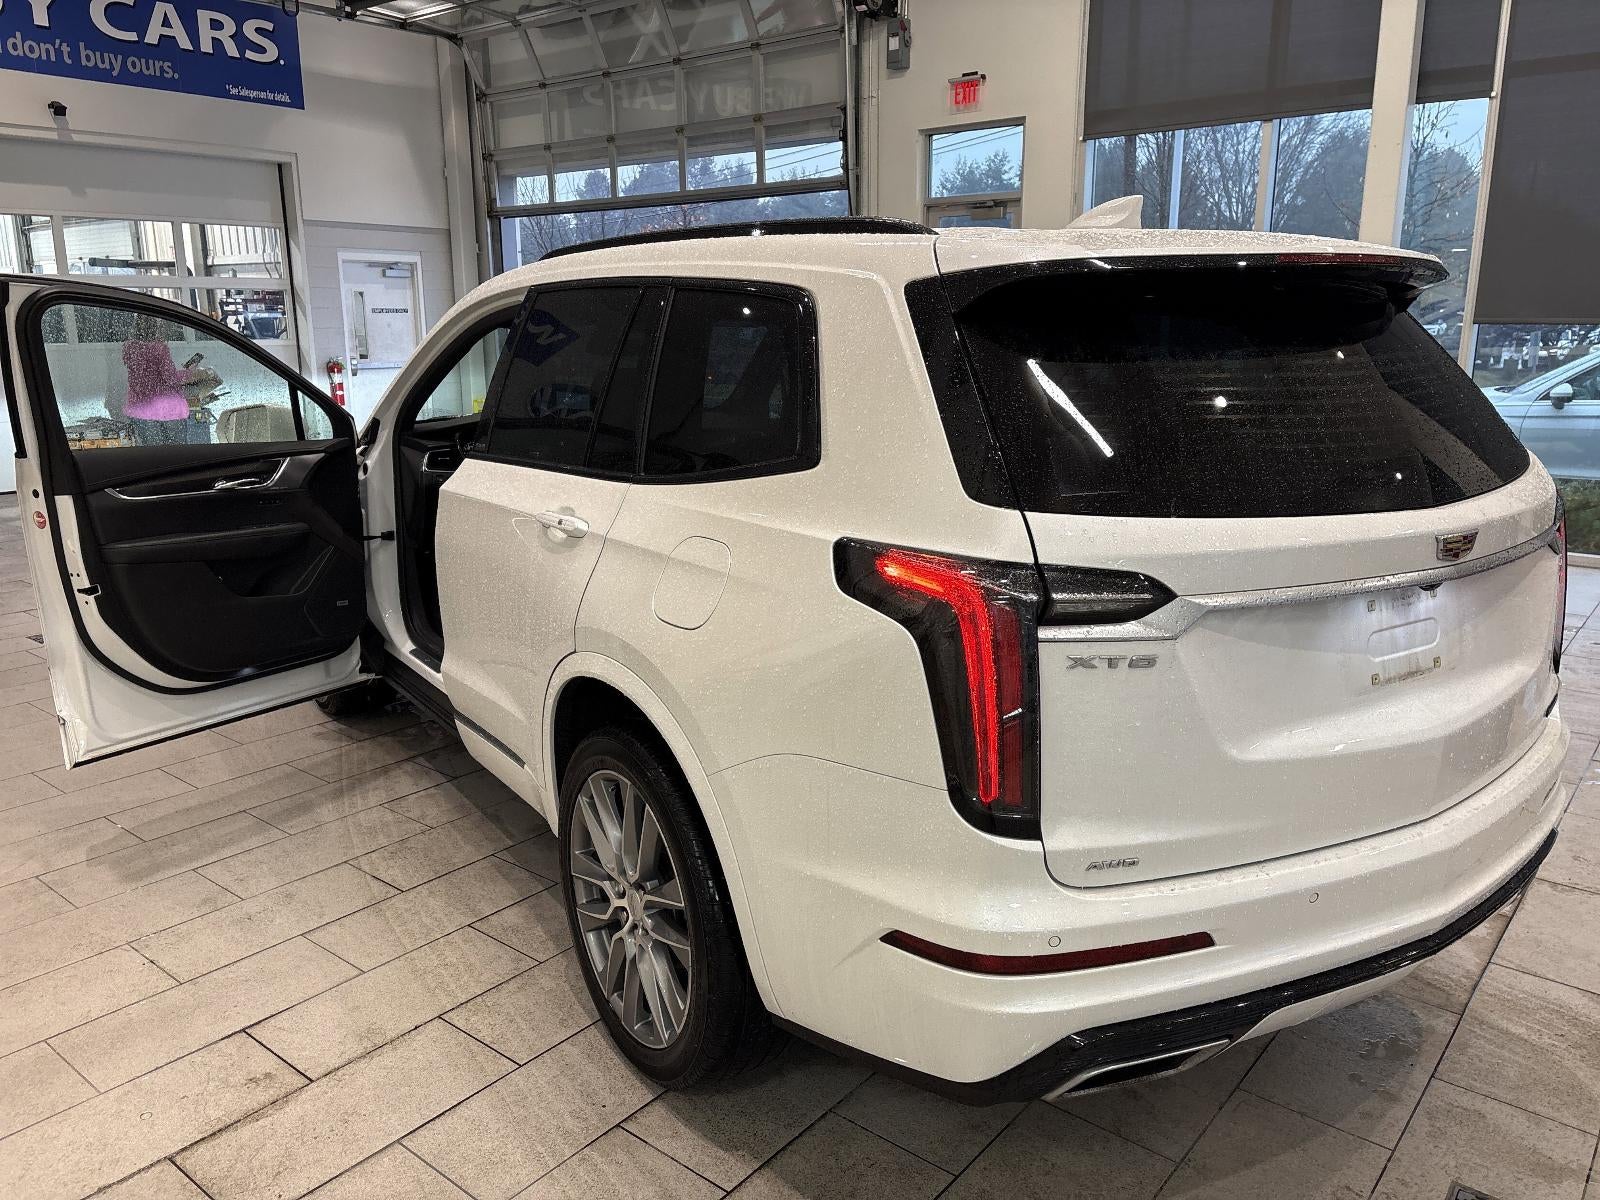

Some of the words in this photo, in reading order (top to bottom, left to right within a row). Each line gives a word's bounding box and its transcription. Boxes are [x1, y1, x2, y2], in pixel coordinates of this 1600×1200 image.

[6, 31, 73, 64] don't
[79, 42, 122, 77] buy
[126, 56, 179, 79] ours.
[239, 86, 267, 100] Salesperson
[266, 90, 274, 100] for
[954, 81, 978, 104] EXIT
[1065, 654, 1159, 670] XT6
[1085, 858, 1139, 871] AWD
